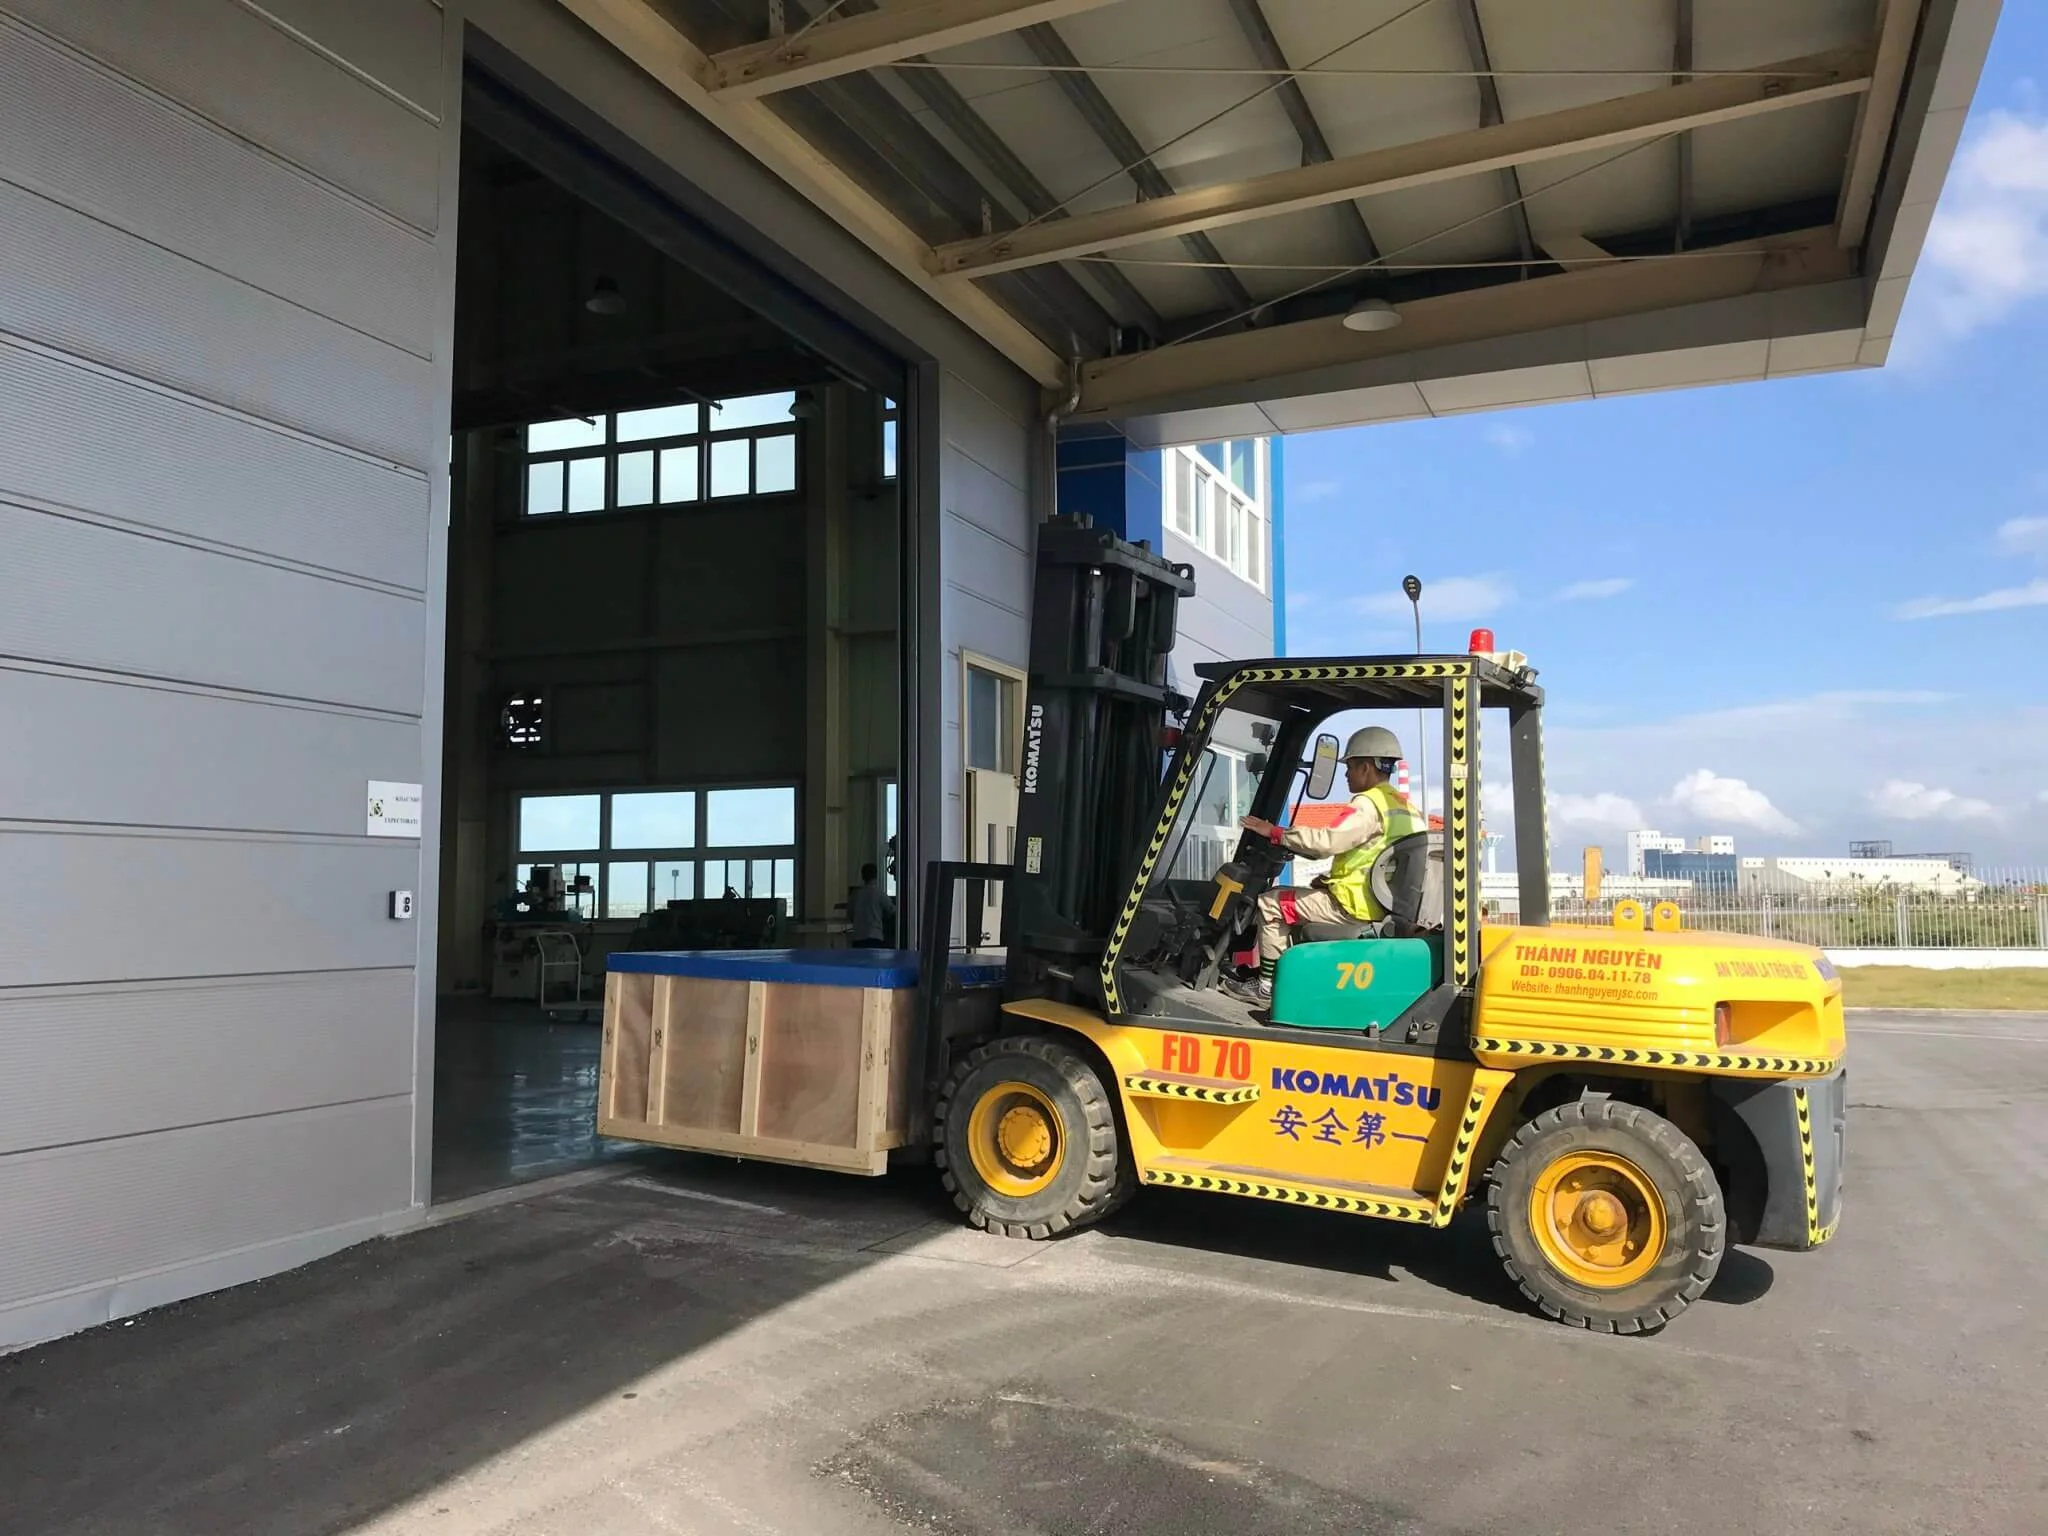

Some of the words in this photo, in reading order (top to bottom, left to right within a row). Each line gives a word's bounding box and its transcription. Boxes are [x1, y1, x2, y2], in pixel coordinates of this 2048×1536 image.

[1024, 704, 1044, 794] KOMATSU
[1336, 961, 1375, 990] 70
[1511, 979, 1552, 994] Website:
[1555, 982, 1658, 1001] thanhnguyenjsc.com
[1548, 966, 1651, 984] 0906.04.11.78
[1161, 1033, 1200, 1074] FD
[1212, 1039, 1252, 1081] 70
[1272, 1067, 1441, 1111] KOMATSU
[1270, 1105, 1429, 1149] 安全第一
